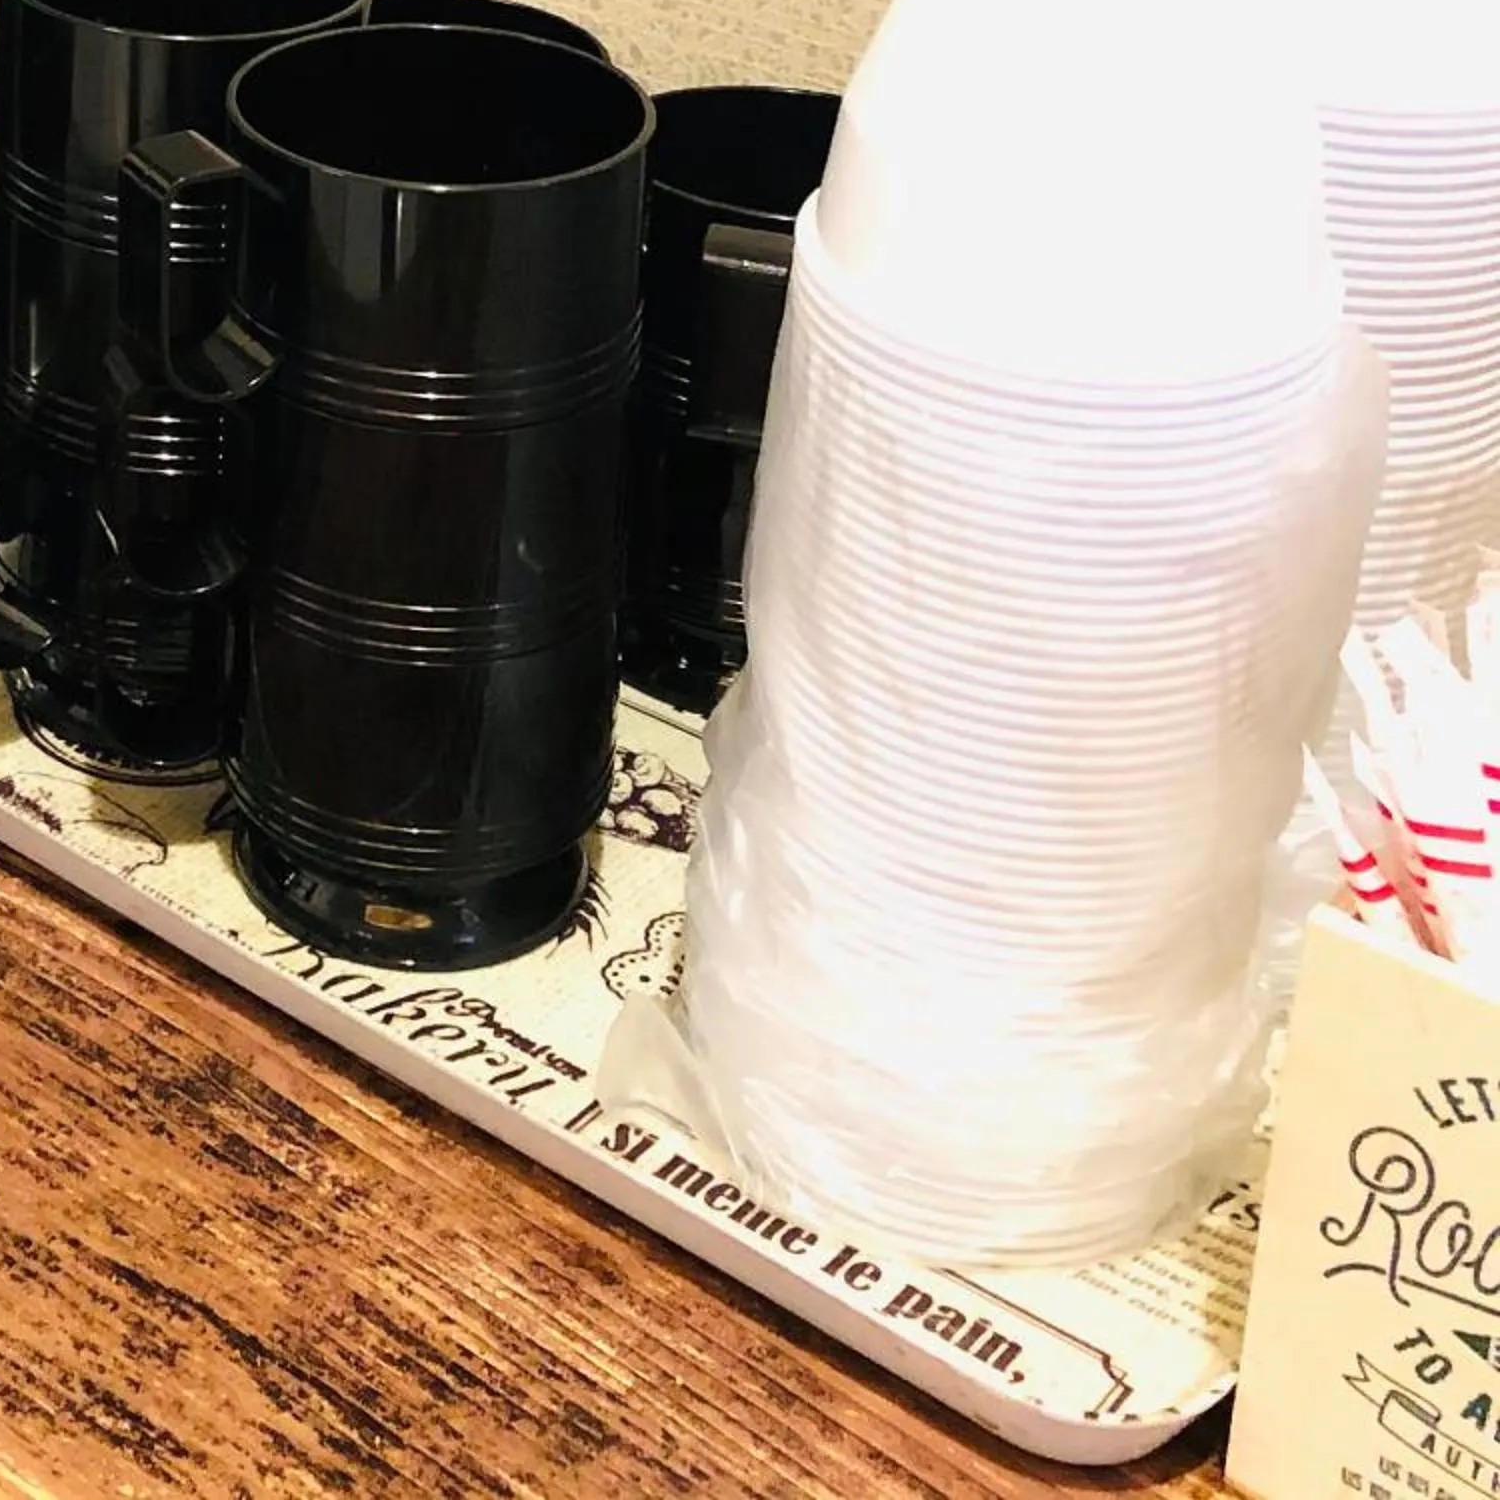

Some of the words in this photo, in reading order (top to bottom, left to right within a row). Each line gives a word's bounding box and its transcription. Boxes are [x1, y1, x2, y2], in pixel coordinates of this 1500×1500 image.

[1413, 1076, 1500, 1128] LET
[601, 1121, 659, 1164] si
[820, 1244, 883, 1292] le
[881, 1283, 1025, 1384] pain,
[1393, 1326, 1452, 1385] TO
